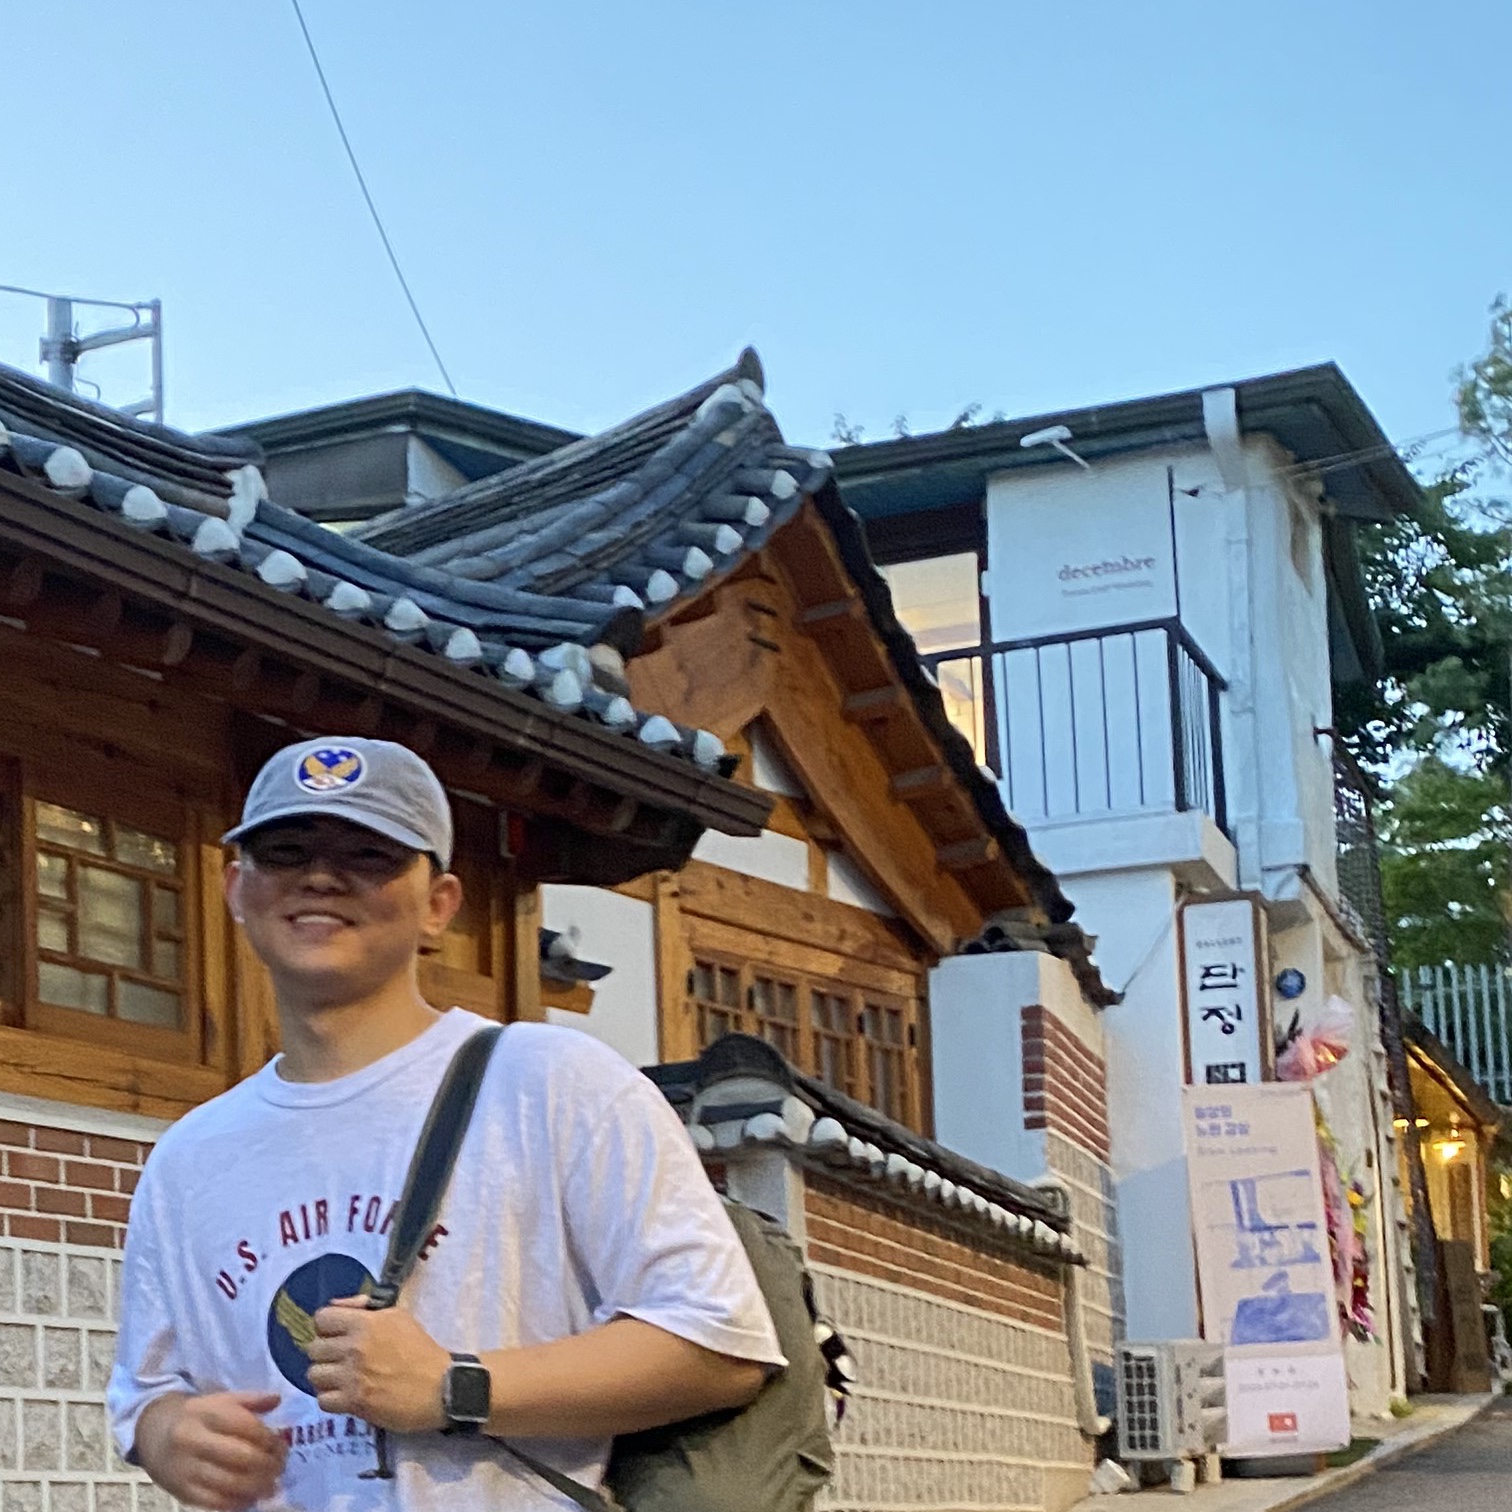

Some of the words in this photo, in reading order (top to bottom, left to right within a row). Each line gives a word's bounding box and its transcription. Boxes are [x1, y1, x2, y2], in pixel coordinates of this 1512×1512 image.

[216, 1240, 267, 1300] U.S.
[279, 1199, 330, 1247] AIR
[347, 1195, 449, 1261] FOE
